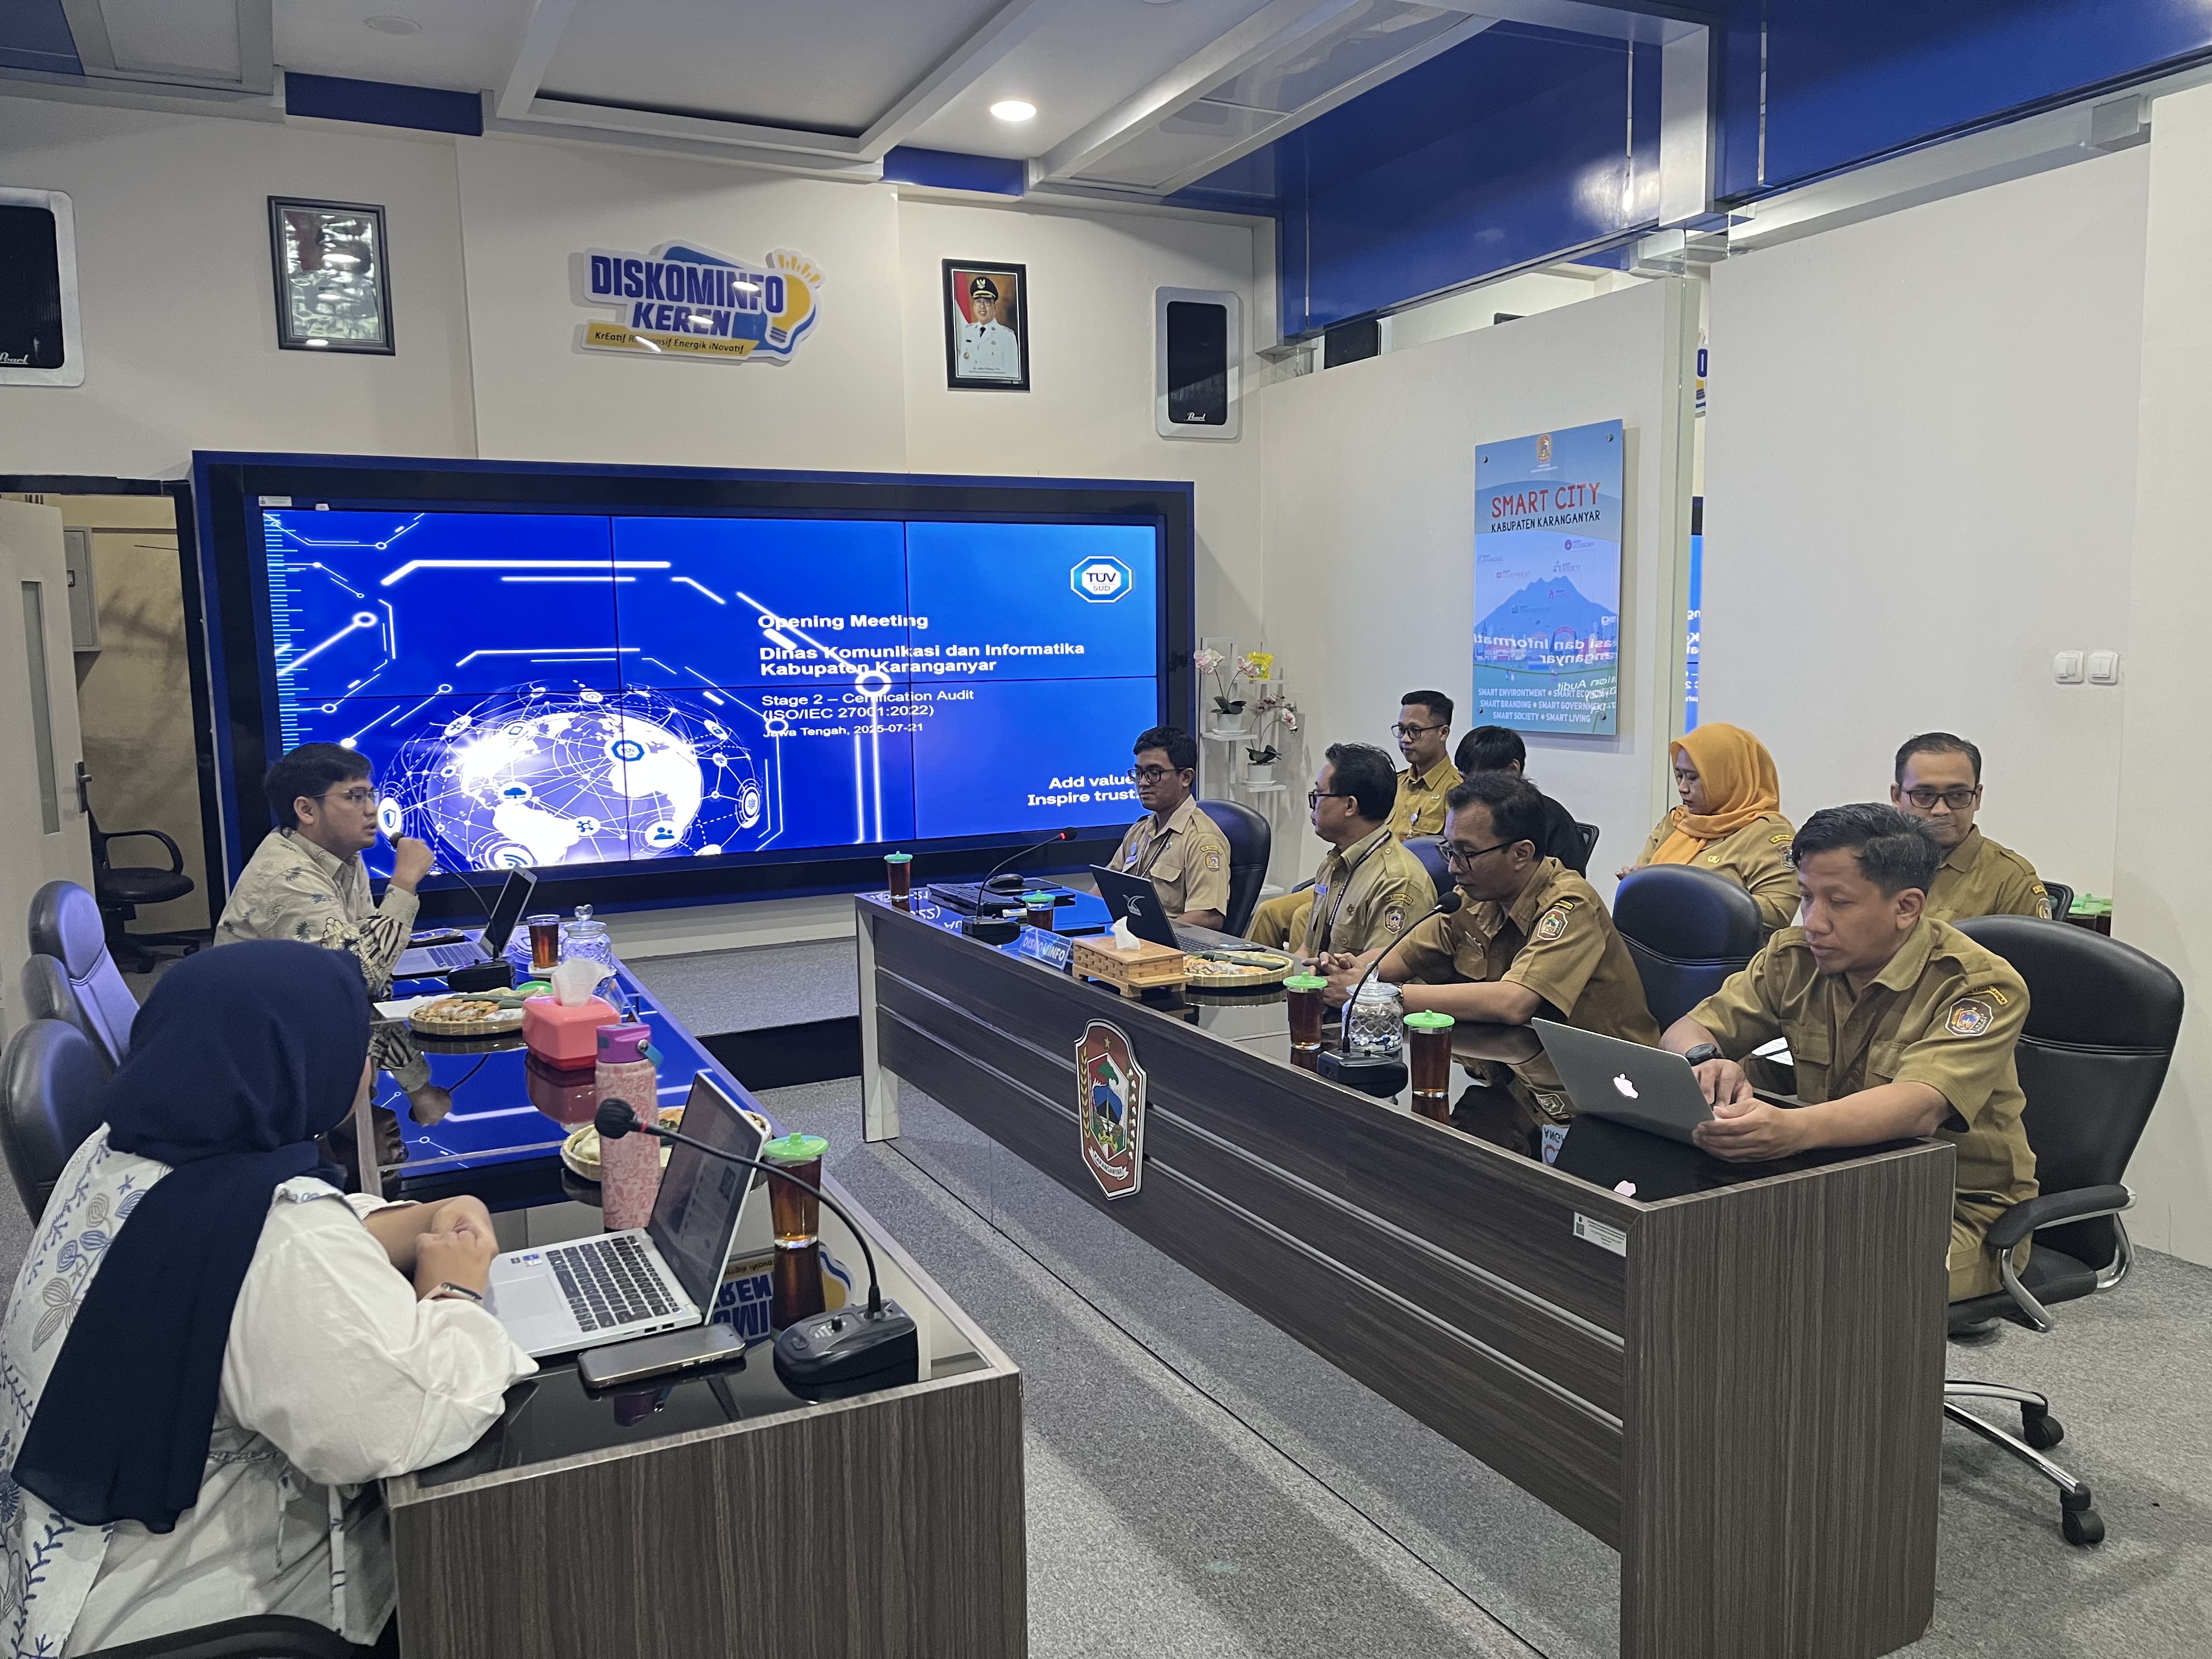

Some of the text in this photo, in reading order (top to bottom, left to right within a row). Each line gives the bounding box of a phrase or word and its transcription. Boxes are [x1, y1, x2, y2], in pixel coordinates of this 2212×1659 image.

[591, 255, 783, 313] DISKOMINFO
[632, 302, 732, 337] KEREN
[674, 339, 707, 350] Energik
[1492, 482, 1601, 518] SMART CITY
[1491, 510, 1600, 533] KABUPATEN KARANGANYAR
[758, 614, 928, 630] Opening Meeting
[760, 642, 1085, 660] Dinas Komunikasi dan Informatika
[760, 660, 996, 678] Kabupaten Karanganyar
[761, 695, 808, 707] Stage
[813, 694, 823, 704] 2
[936, 690, 974, 701] Audit
[1478, 688, 1498, 696] SMART
[1499, 689, 1547, 697] ENVIRONTMENT
[1553, 689, 1575, 698] SMART
[763, 704, 934, 722] (ISO/IEC 27001:2022)
[1500, 700, 1532, 708] BRANDING
[1538, 701, 1560, 709] SMART
[1493, 711, 1591, 723] SMART SOCIETY SMART LIVING
[799, 726, 850, 737] Tengah,
[854, 723, 923, 734] 2025-07-21
[1048, 776, 1085, 789] Add
[1028, 789, 1140, 806] Inspire trust.
